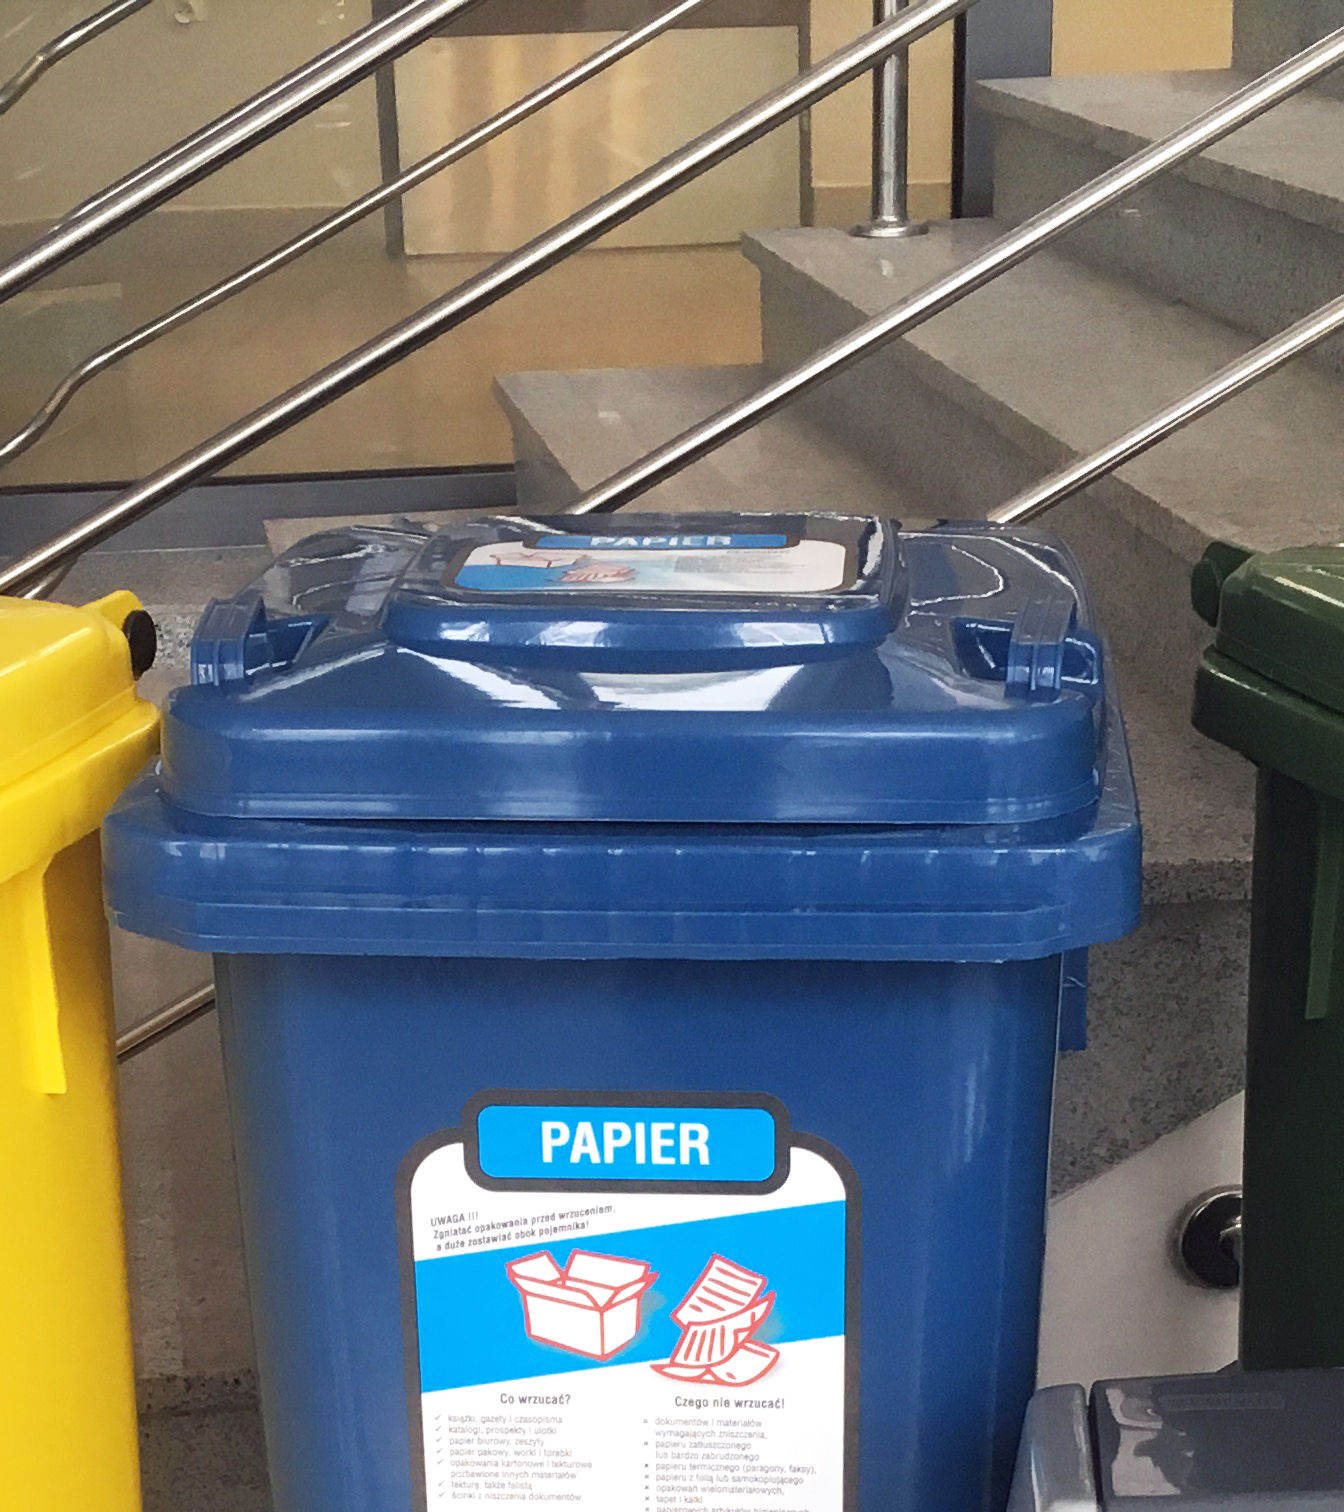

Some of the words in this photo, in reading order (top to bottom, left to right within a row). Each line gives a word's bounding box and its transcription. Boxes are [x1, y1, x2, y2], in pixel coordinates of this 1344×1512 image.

[590, 535, 732, 547] PAPIER
[541, 1121, 710, 1165] PAPIER
[431, 1213, 465, 1226] UWAGA
[434, 1225, 471, 1239] Zgniatać
[475, 1217, 528, 1233] opakowania
[531, 1212, 555, 1226] przed
[445, 1240, 465, 1250] duże
[468, 1232, 511, 1246] zostawiać
[515, 1229, 535, 1239] obok
[539, 1220, 588, 1237] pojemnika!
[500, 1393, 514, 1404] Co
[518, 1394, 571, 1404] wrzucać?
[675, 1396, 708, 1409] Czego
[713, 1397, 730, 1408] nie
[734, 1398, 784, 1409] wrzucać!
